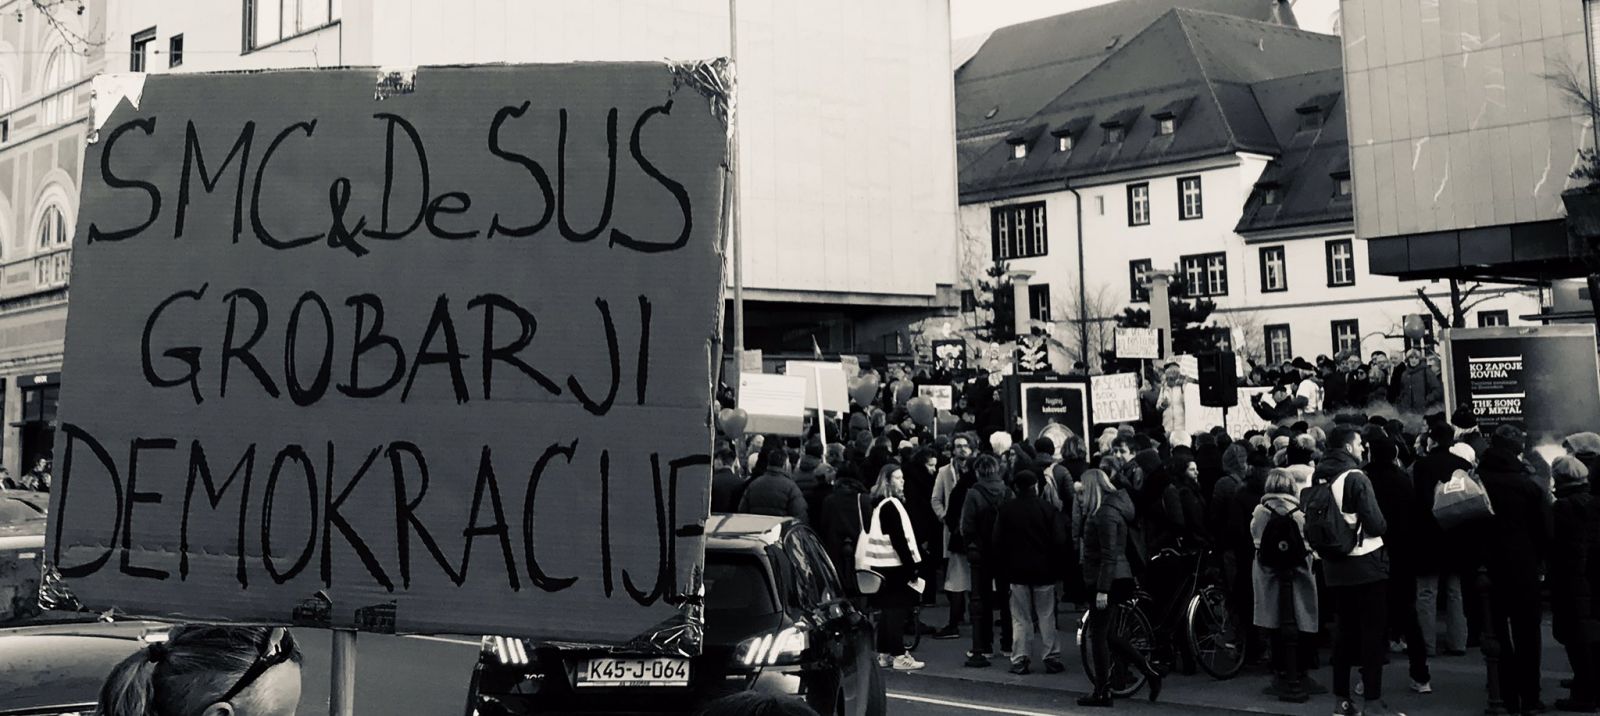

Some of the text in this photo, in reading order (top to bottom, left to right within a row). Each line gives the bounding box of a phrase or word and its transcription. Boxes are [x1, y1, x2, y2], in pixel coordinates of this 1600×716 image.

[141, 283, 651, 415] GROBARJI
[1470, 362, 1522, 371] KO ZAPOJE
[1470, 370, 1508, 379] KOVINA
[1472, 398, 1521, 408] THE SONG
[1473, 406, 1522, 415] OF METAL
[53, 422, 711, 605] DEMOKRACIJE
[590, 660, 686, 679] K45-J-064
